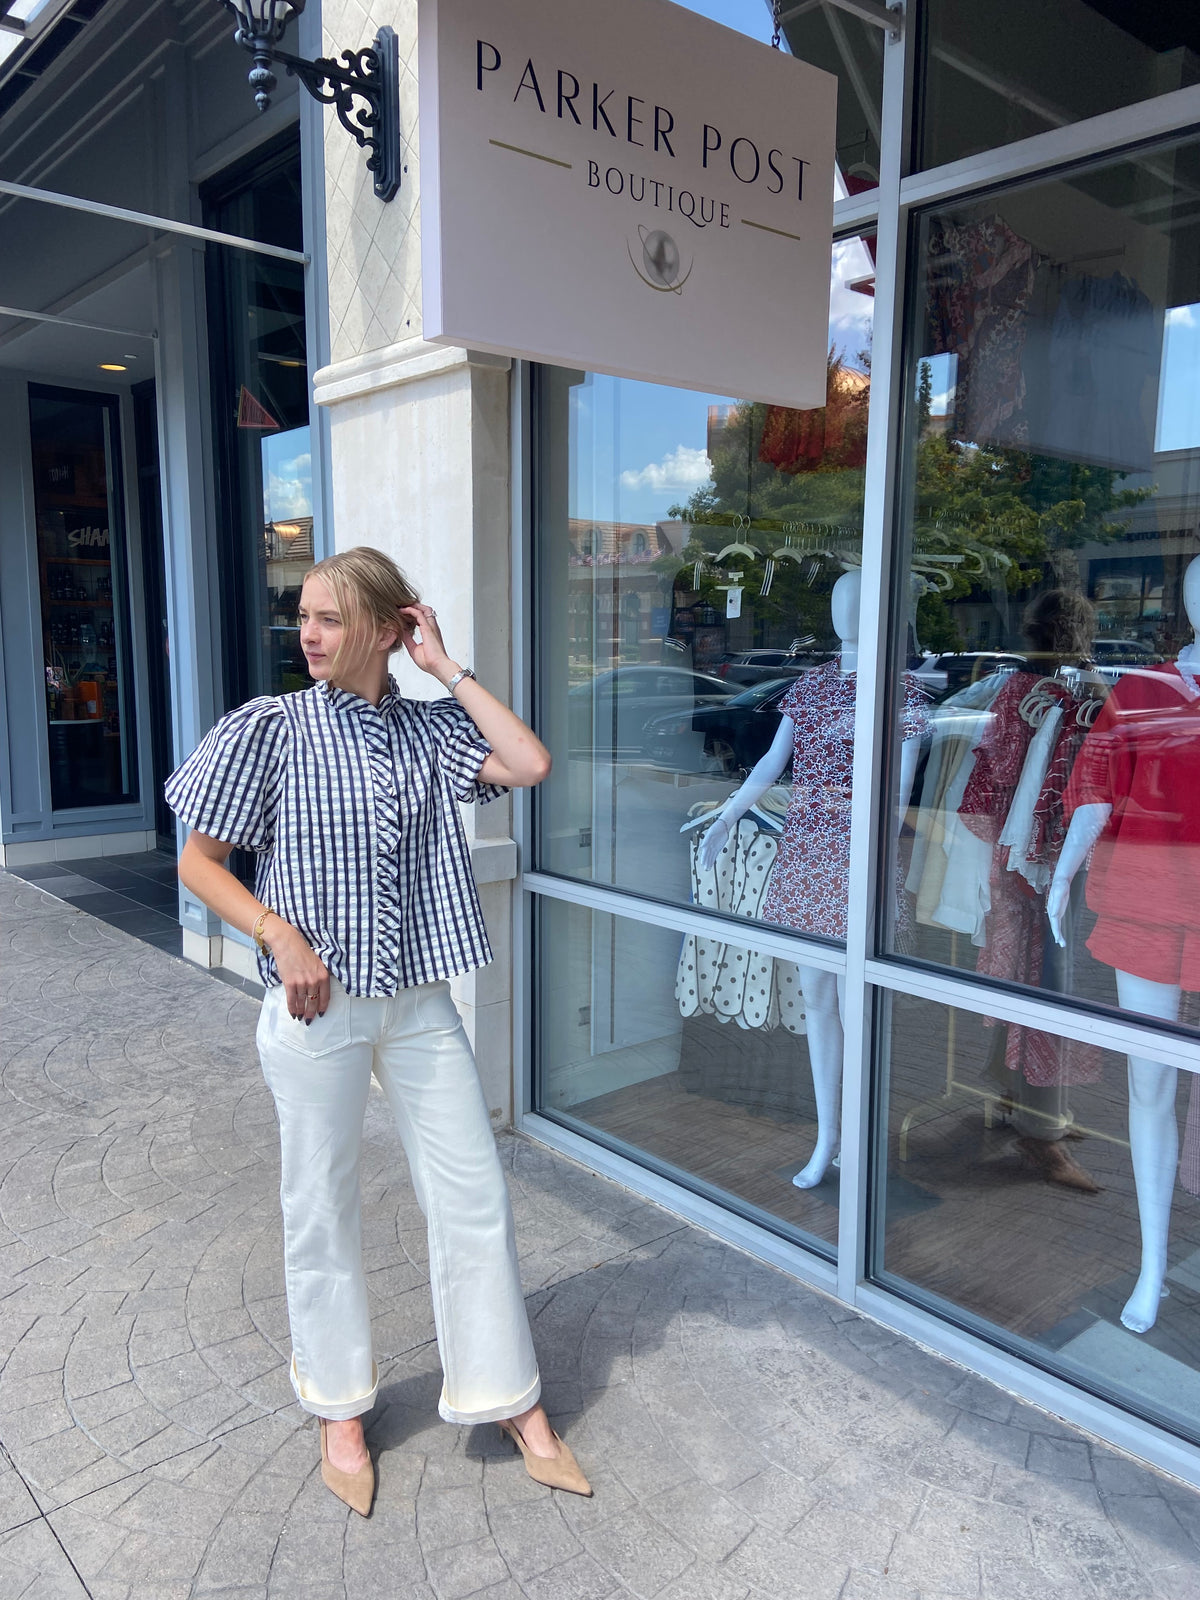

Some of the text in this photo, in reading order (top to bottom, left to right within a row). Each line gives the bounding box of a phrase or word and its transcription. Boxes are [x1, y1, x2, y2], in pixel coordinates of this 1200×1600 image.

[476, 39, 811, 201] PARKER POST
[587, 160, 730, 229] BOUTIQUE
